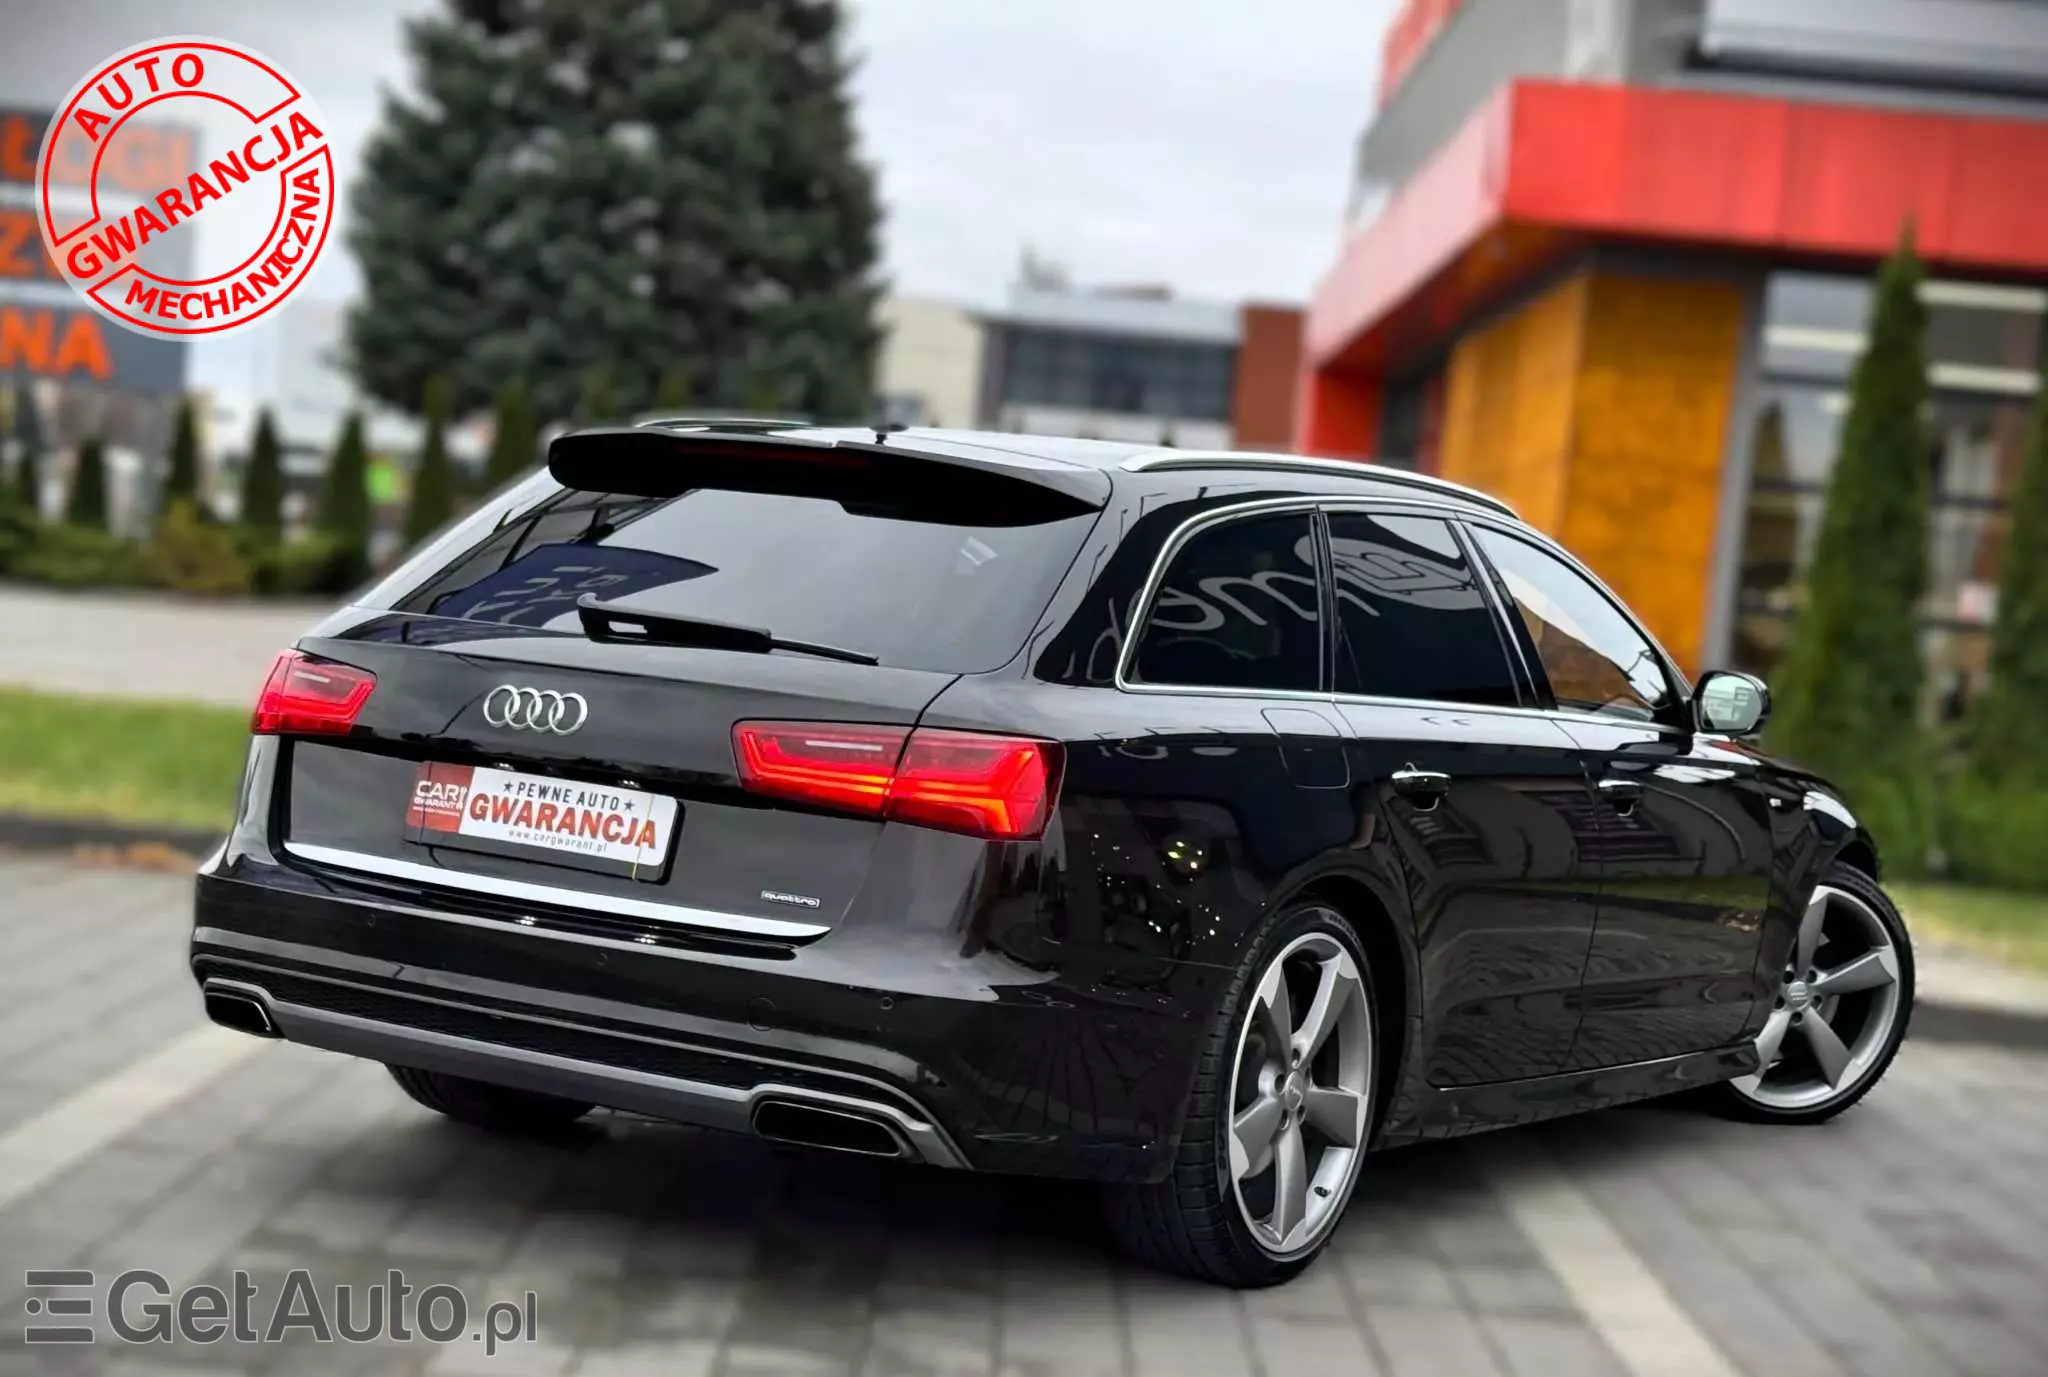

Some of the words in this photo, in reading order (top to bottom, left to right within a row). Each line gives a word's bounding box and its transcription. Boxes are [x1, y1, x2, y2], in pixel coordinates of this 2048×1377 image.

[516, 781, 573, 804] PEWNE
[575, 791, 620, 811] AUTO
[469, 792, 657, 849] GWARANCJA
